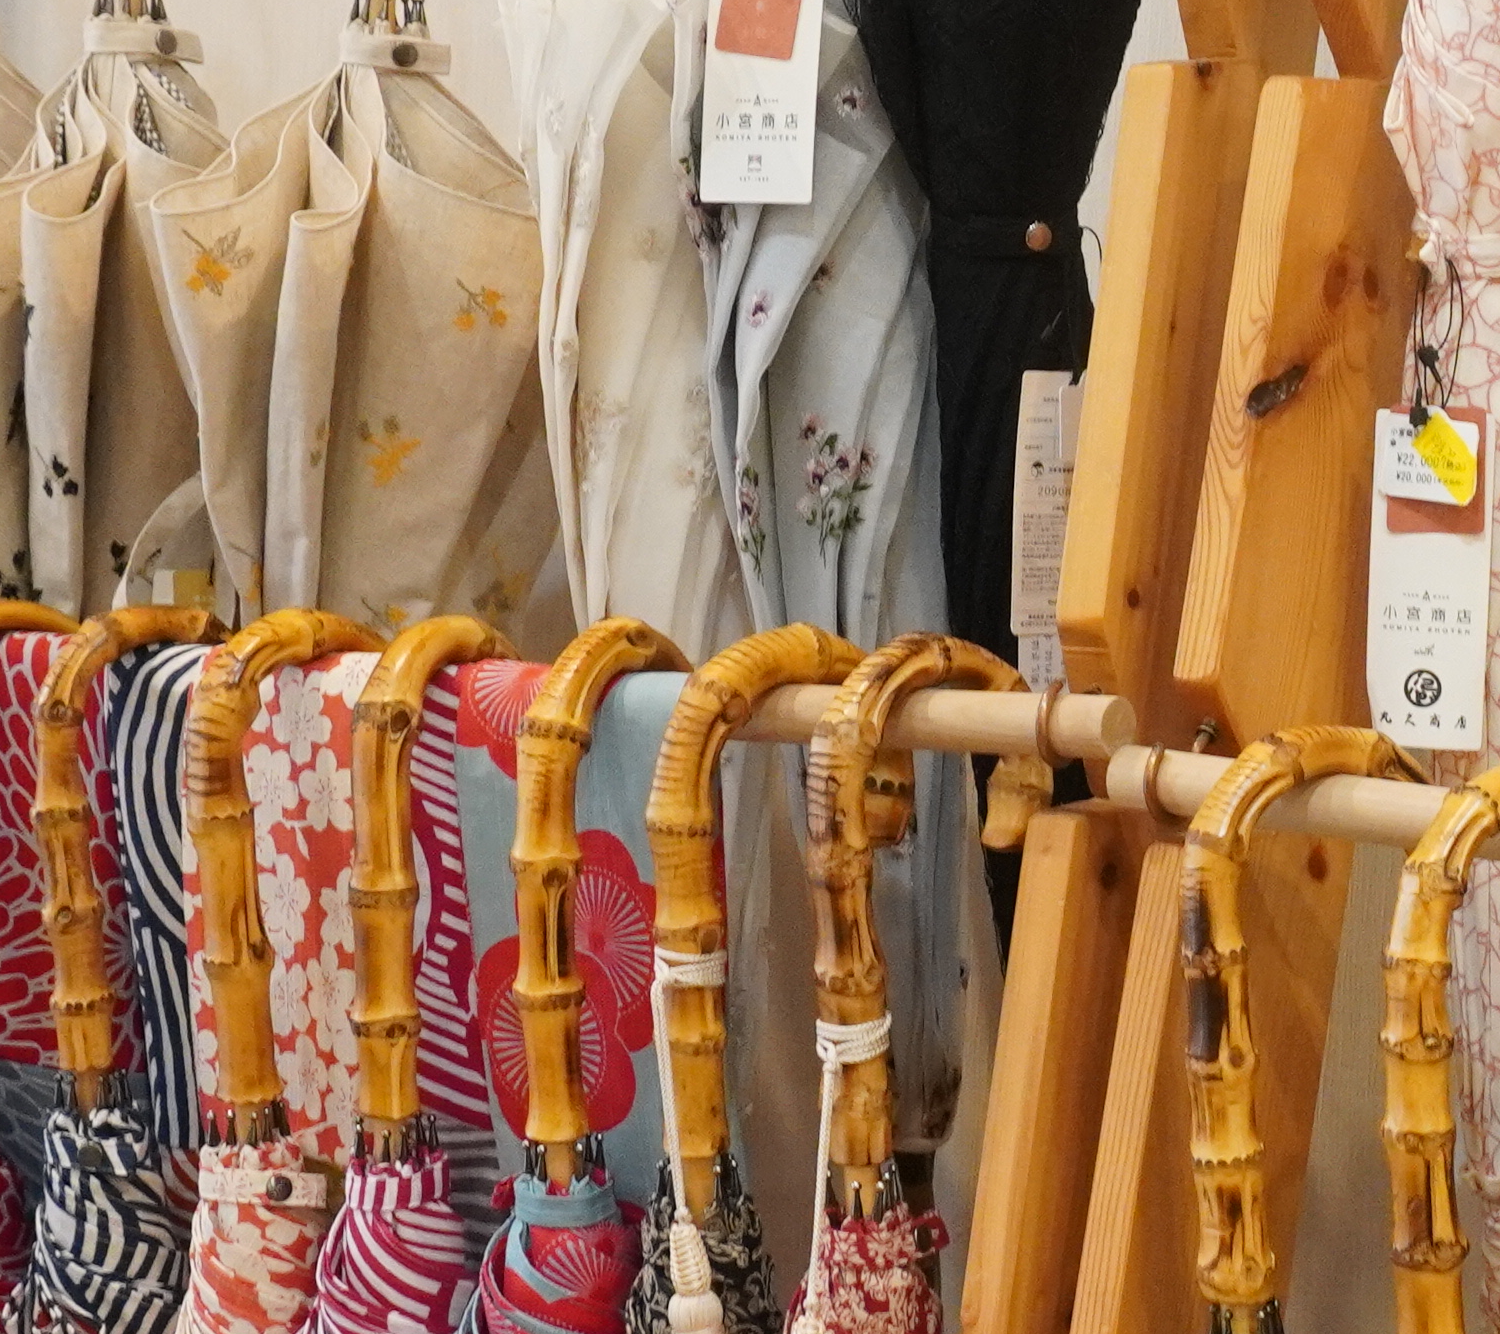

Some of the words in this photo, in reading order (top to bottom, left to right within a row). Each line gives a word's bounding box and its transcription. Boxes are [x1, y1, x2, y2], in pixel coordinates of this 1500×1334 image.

[715, 113, 799, 130] 小宮商店
[1383, 604, 1472, 624] 小宮商店
